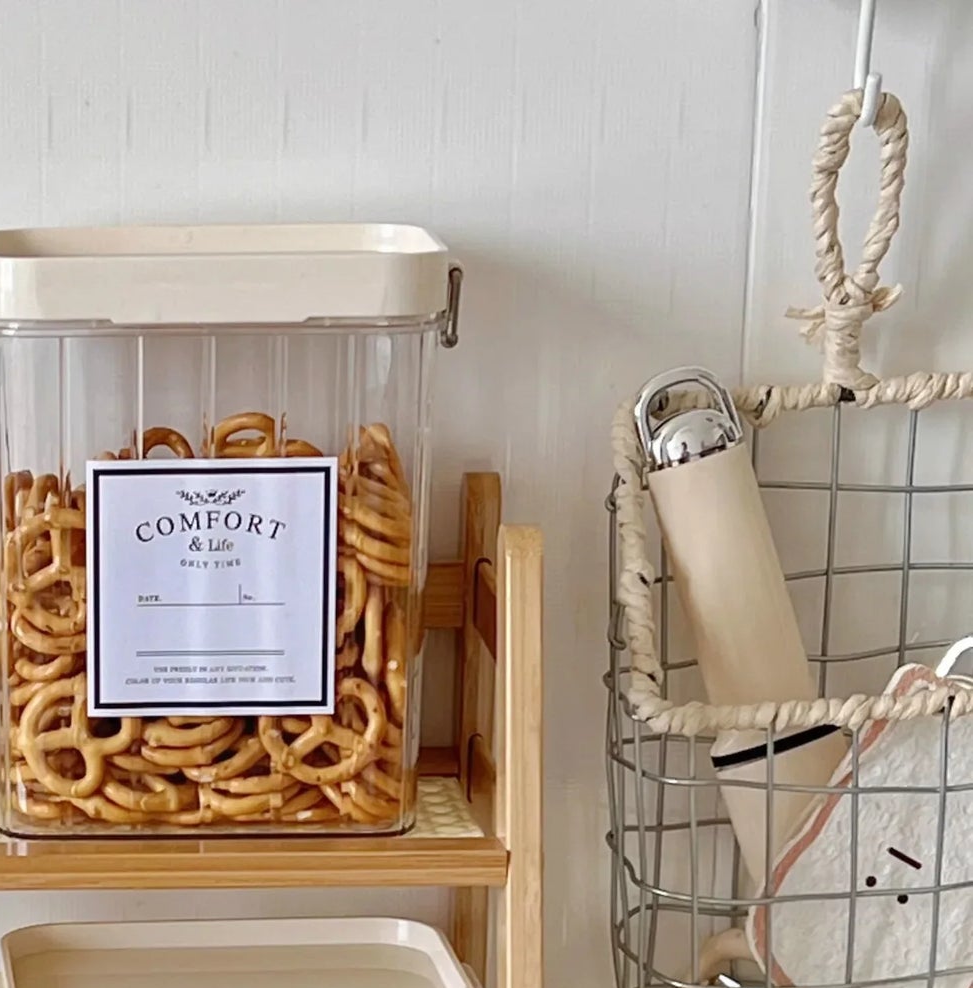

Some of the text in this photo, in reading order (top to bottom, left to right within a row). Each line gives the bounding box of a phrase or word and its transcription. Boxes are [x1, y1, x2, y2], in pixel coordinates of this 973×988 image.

[135, 510, 287, 543] COMFORT
[188, 536, 235, 552] & Life
[214, 558, 241, 569] TIME
